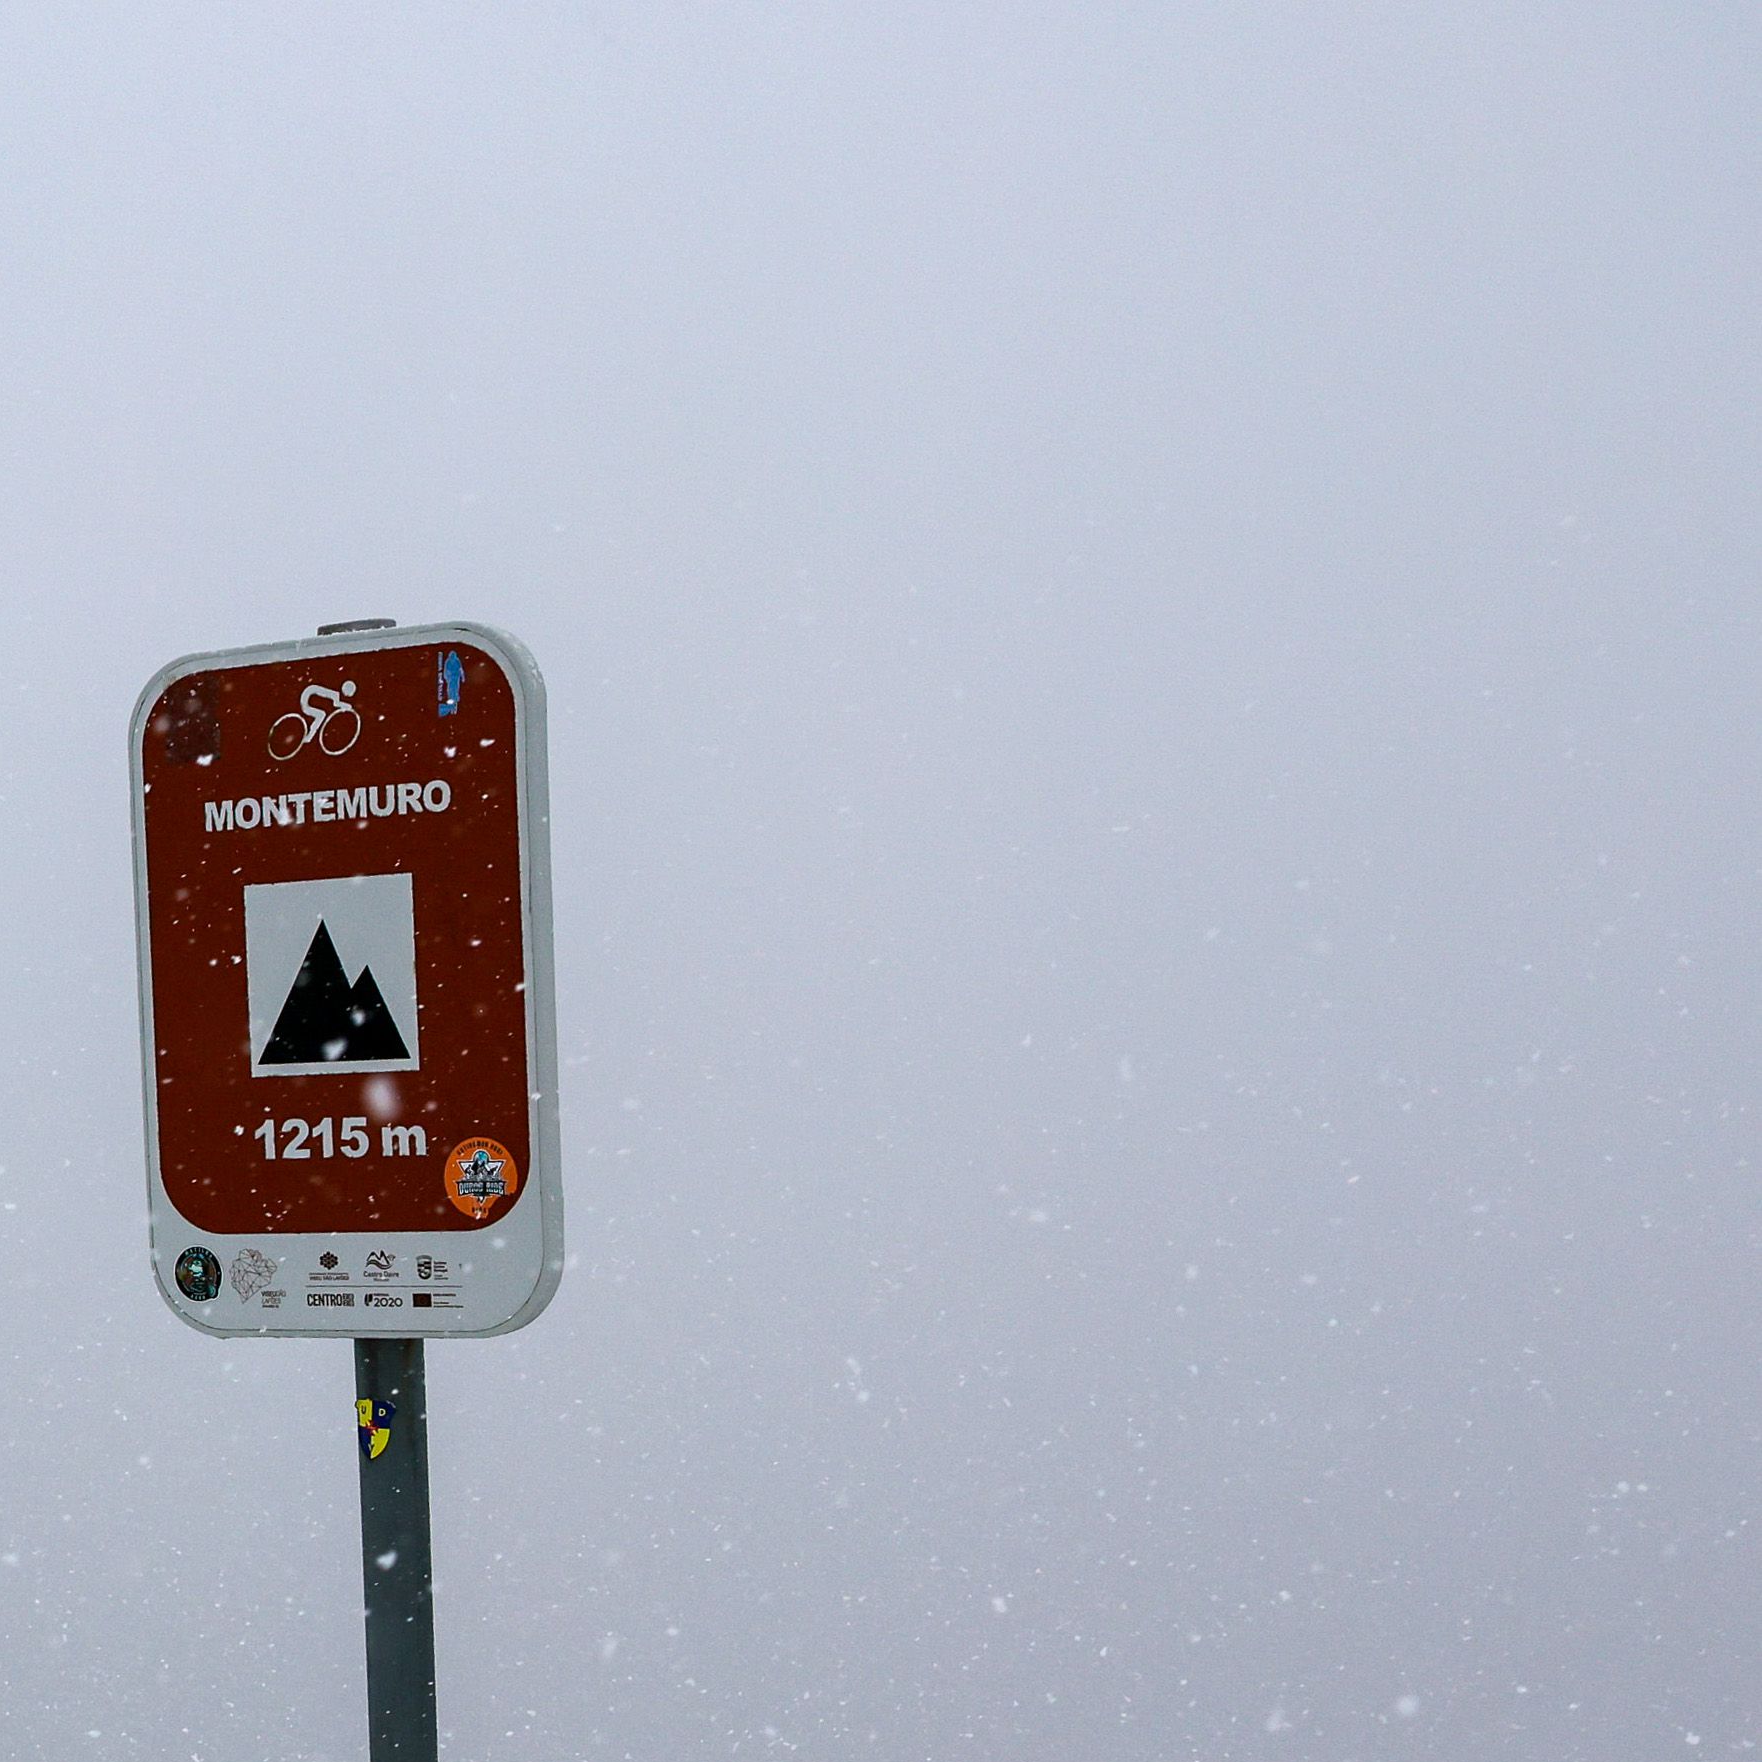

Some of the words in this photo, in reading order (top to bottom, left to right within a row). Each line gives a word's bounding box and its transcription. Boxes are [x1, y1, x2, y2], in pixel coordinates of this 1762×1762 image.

[204, 779, 452, 833] MONTEMURO
[254, 1116, 370, 1160] 1215
[381, 1125, 427, 1157] m
[306, 1293, 343, 1307] CENTRO
[373, 1297, 404, 1308] 2020
[378, 1408, 386, 1416] D
